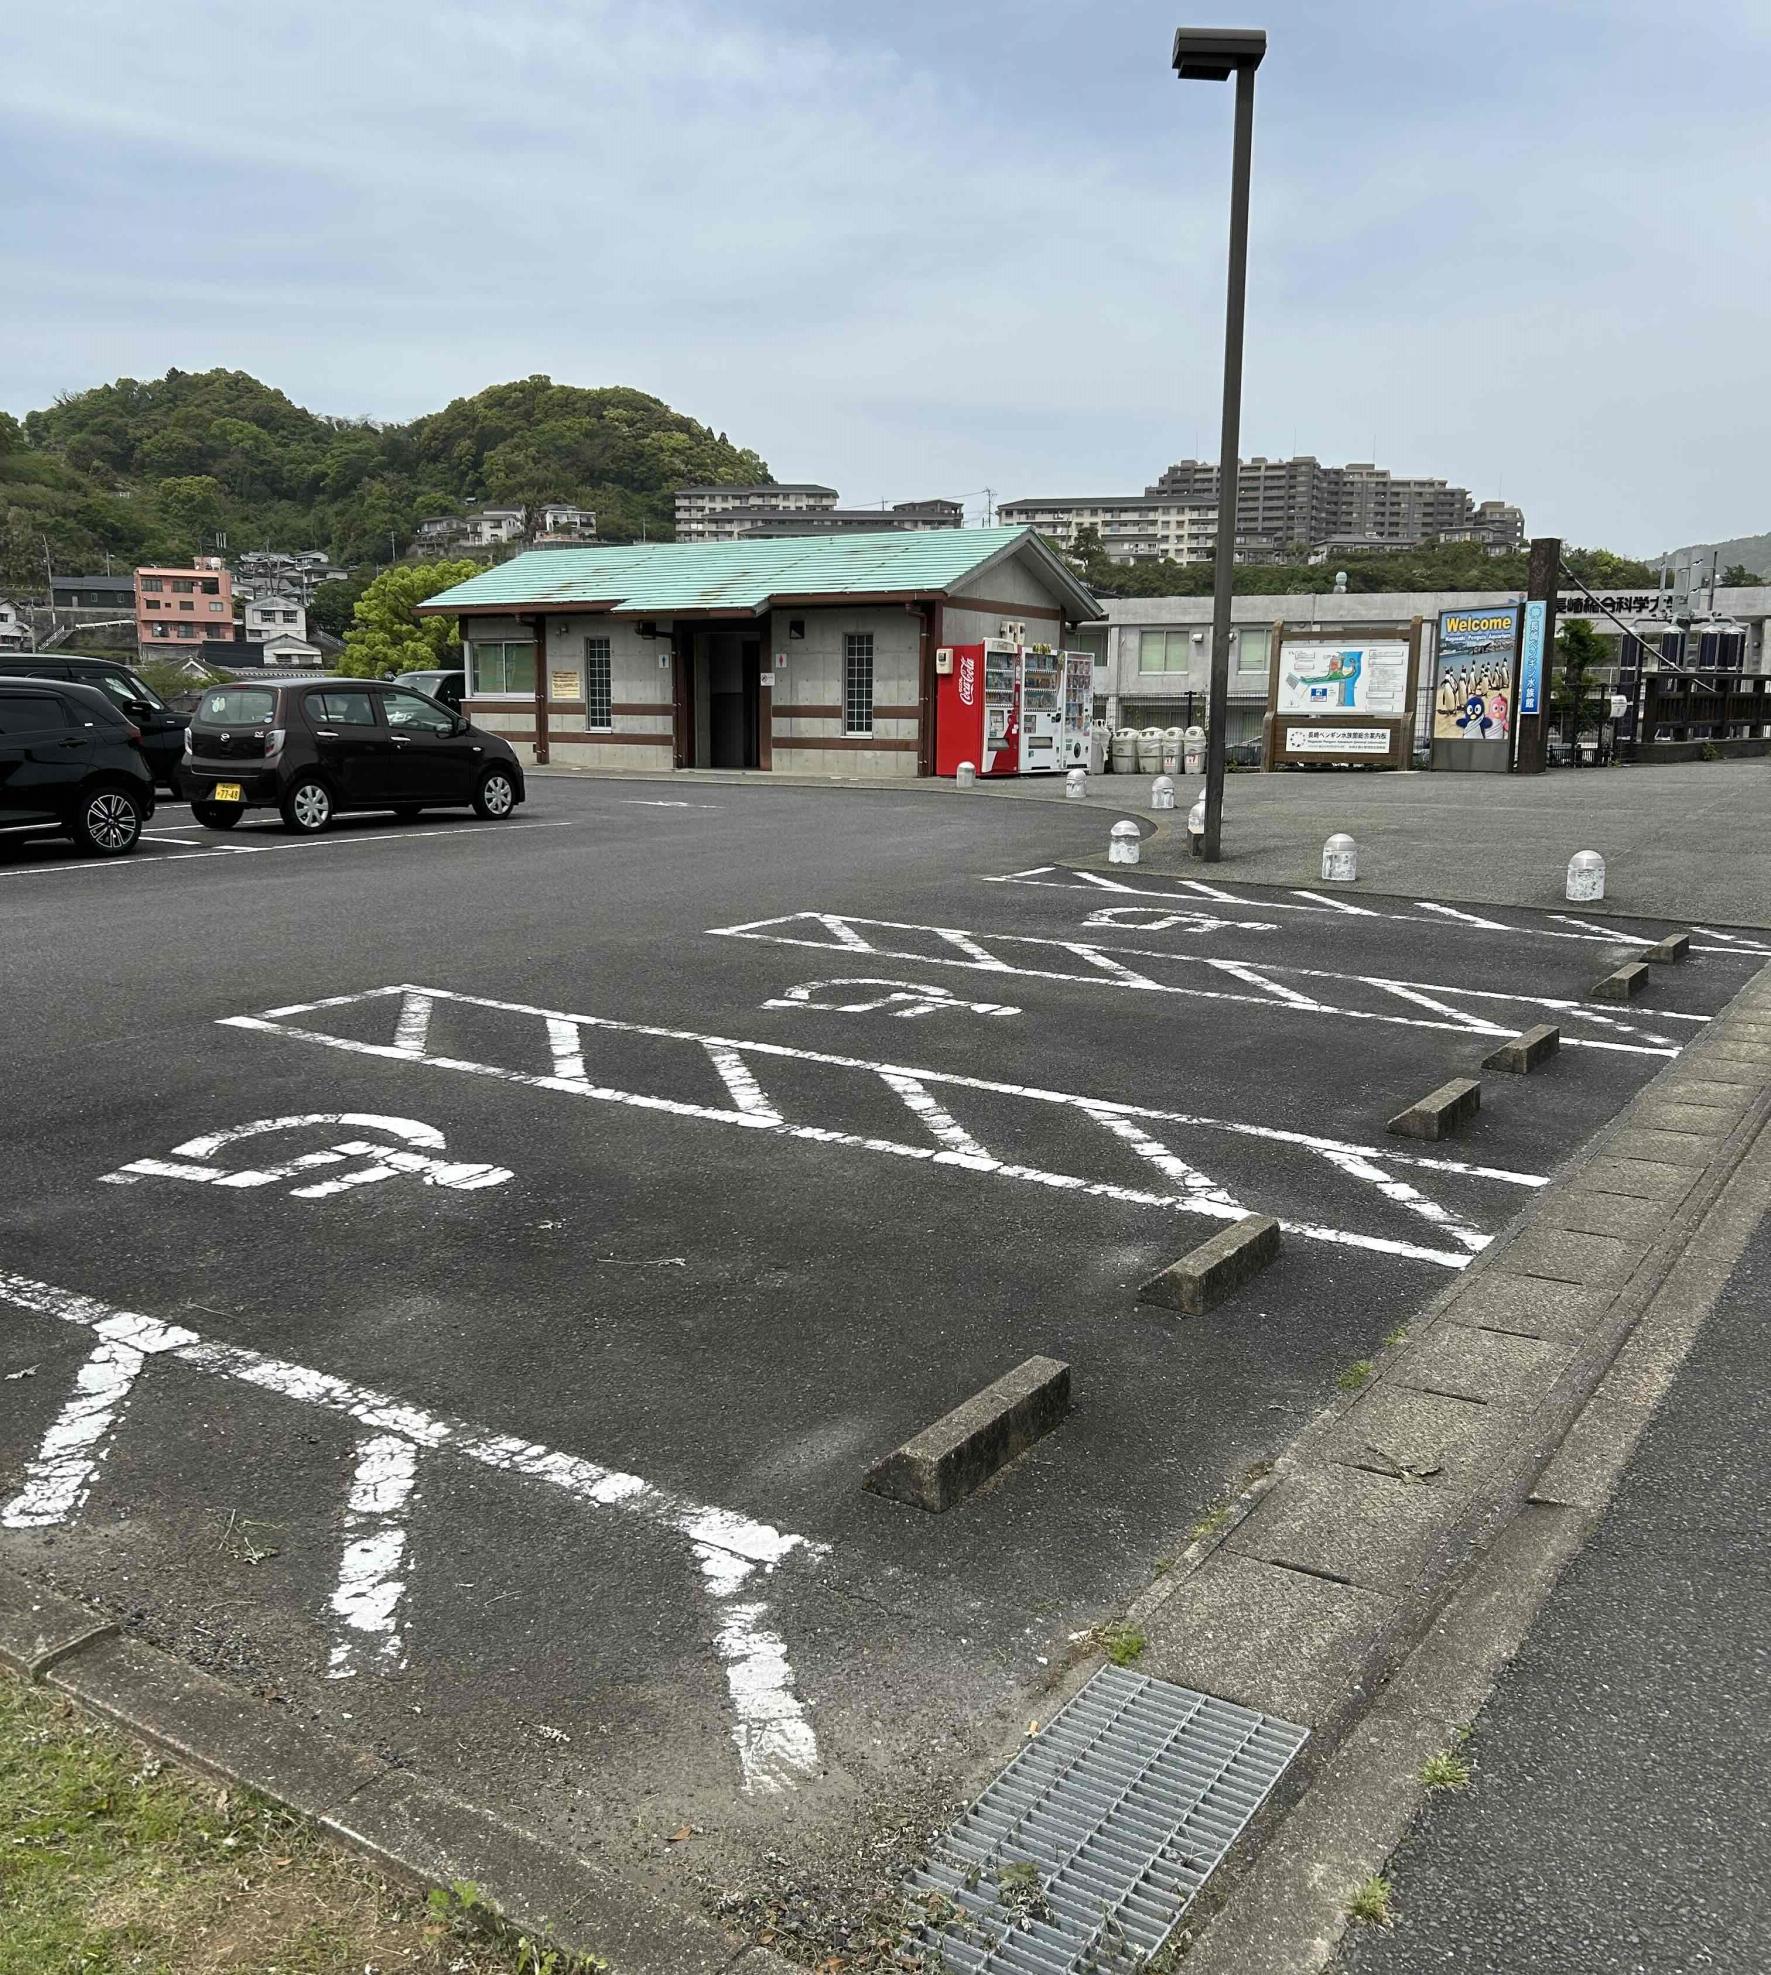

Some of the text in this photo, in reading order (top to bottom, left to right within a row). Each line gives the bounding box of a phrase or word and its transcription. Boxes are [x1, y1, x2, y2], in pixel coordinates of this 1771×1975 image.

[1446, 615, 1512, 633] Welcome
[960, 655, 975, 705] Coca-Cola
[1525, 621, 1540, 709] 長崎ペンギン水族館
